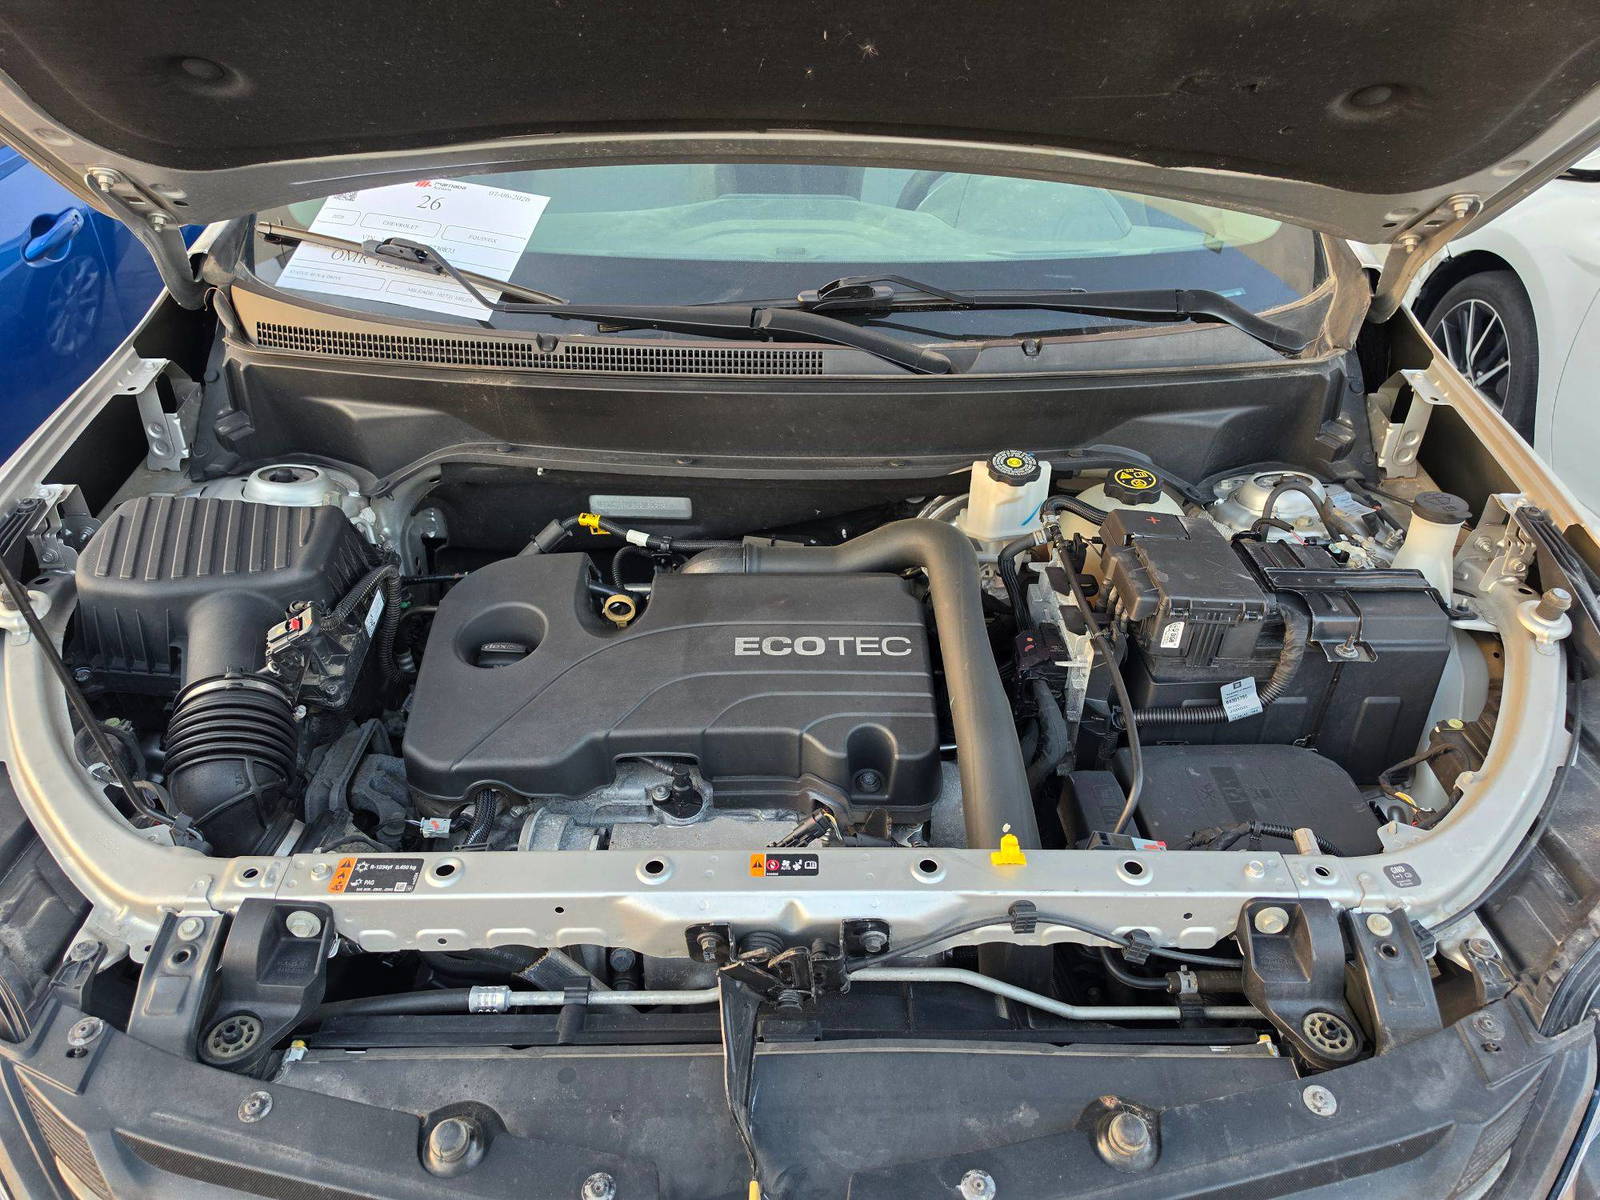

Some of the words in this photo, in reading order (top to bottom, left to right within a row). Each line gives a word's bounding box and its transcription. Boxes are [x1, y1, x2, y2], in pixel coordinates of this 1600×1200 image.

[416, 195, 444, 211] 26
[382, 220, 419, 230] CHEVROLET
[331, 249, 368, 265] OMR
[735, 636, 912, 656] ECOTEC
